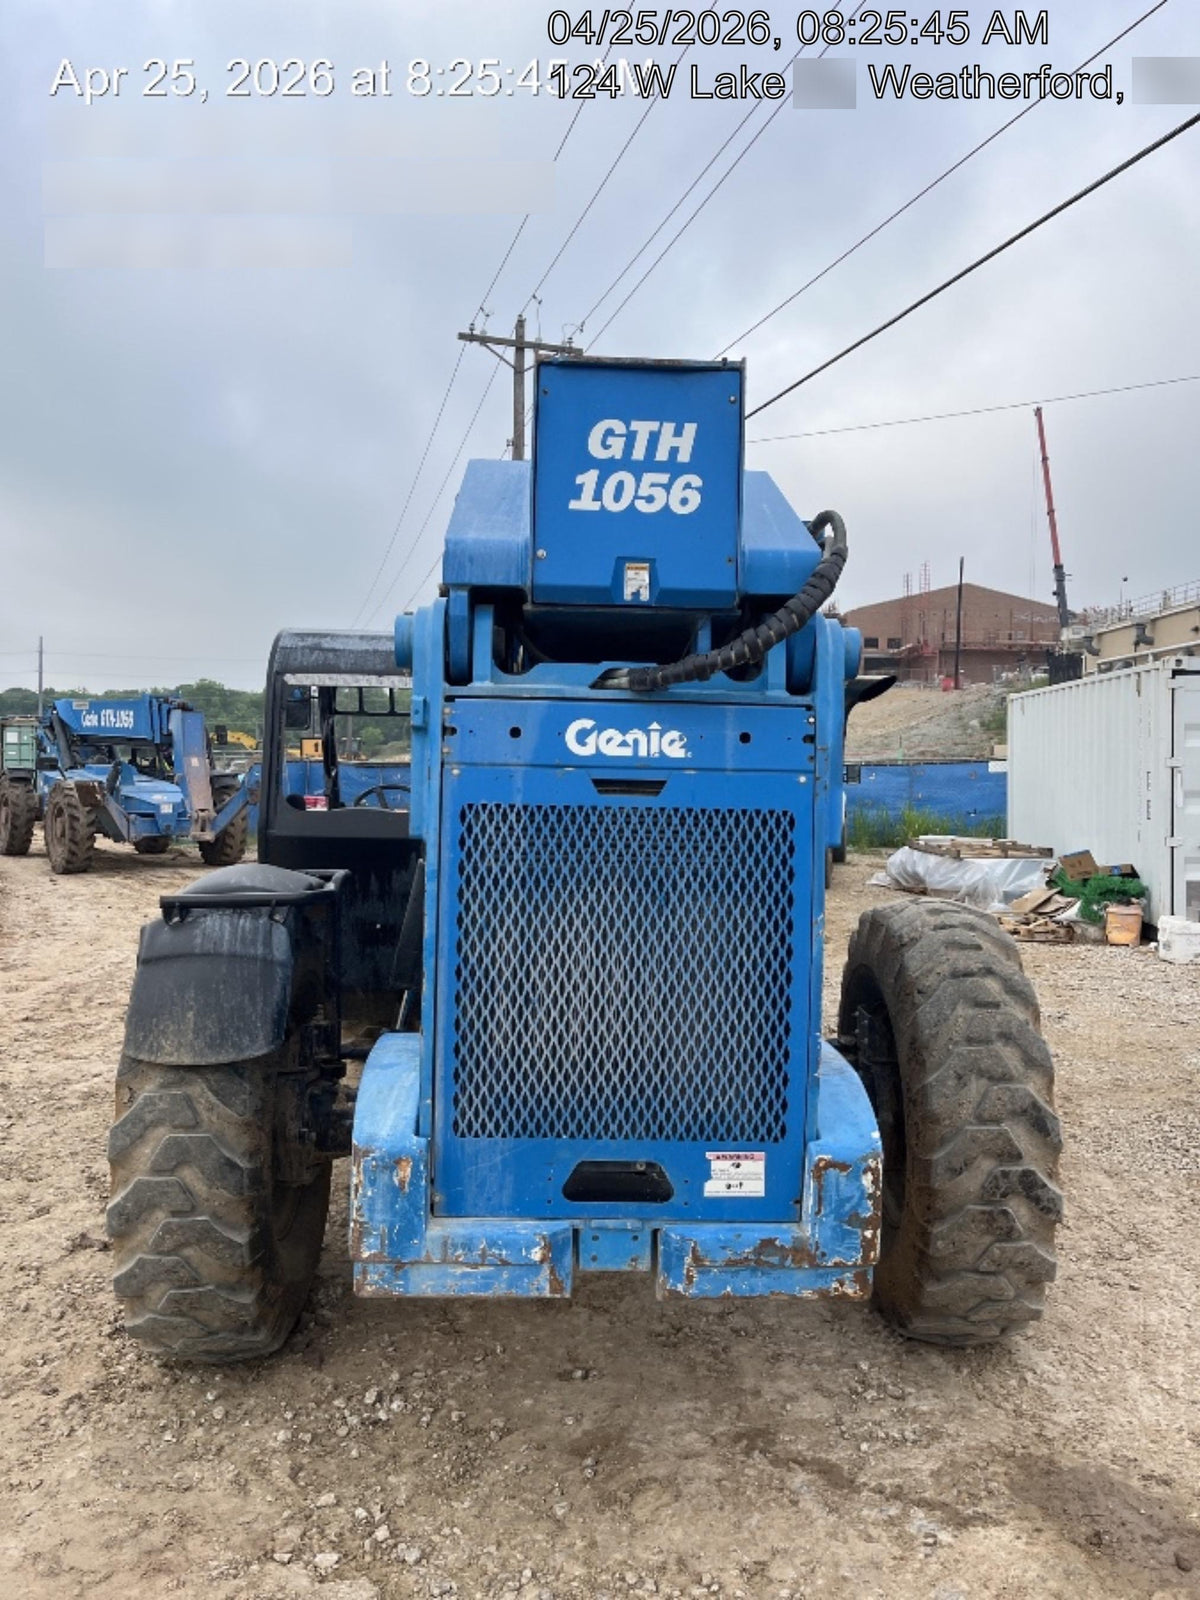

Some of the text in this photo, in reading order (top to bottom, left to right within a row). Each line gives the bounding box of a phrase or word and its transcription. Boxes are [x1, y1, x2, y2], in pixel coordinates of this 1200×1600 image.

[588, 419, 698, 463] GTH
[568, 469, 703, 515] 1056
[565, 718, 688, 758] Genie
